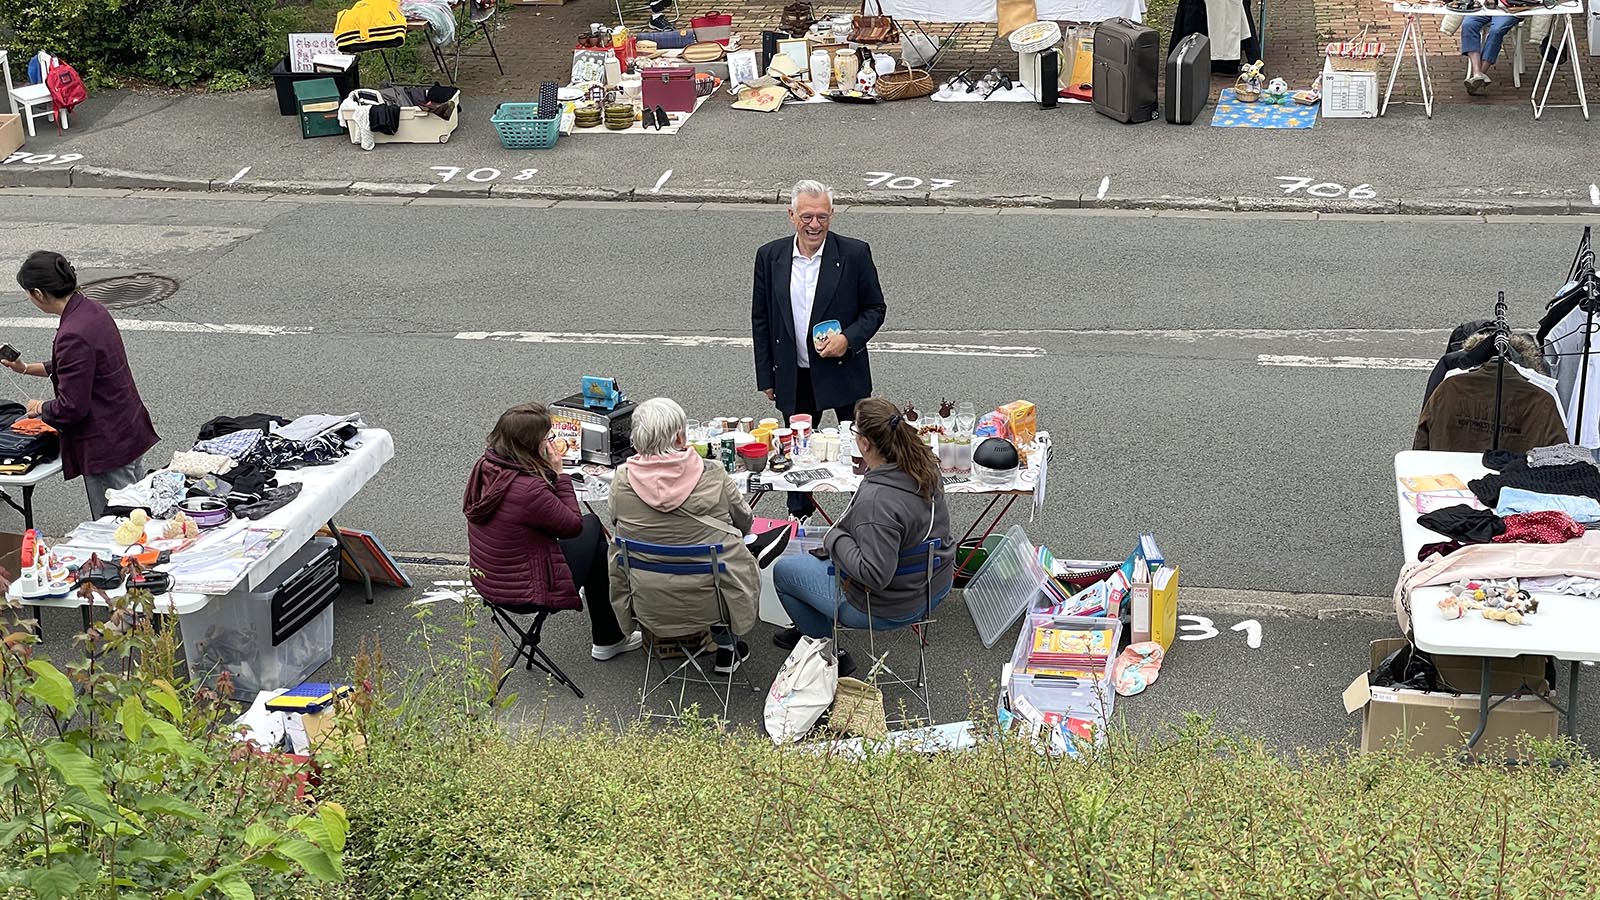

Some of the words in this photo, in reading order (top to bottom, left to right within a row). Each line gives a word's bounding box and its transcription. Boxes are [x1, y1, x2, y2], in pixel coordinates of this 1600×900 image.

[429, 165, 539, 183] 708
[863, 171, 960, 191] 707
[1273, 175, 1377, 199] 706
[552, 421, 578, 432] utella
